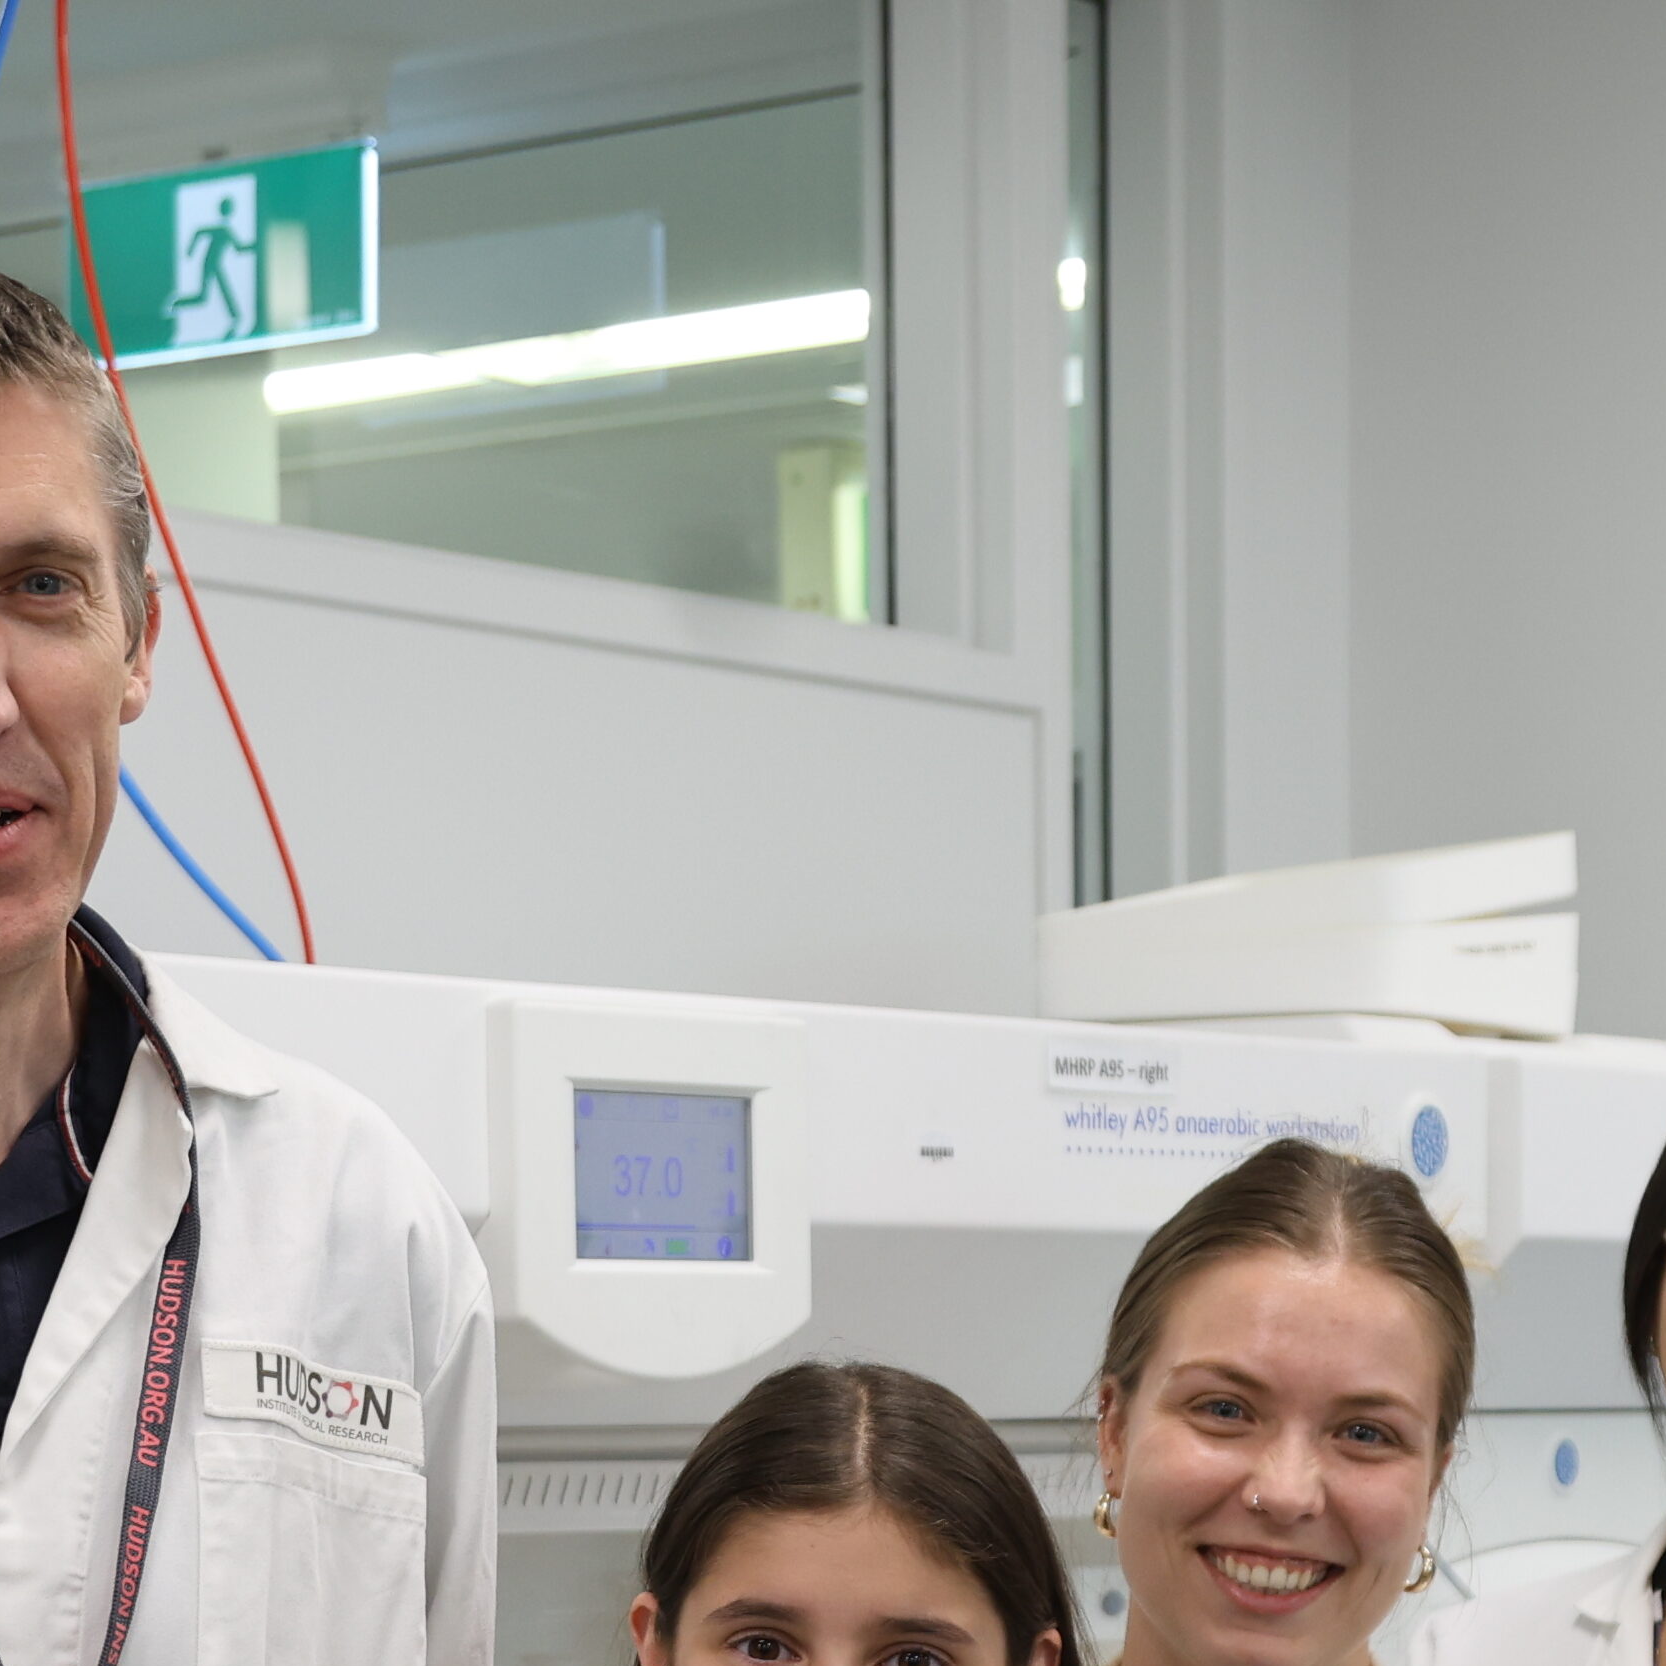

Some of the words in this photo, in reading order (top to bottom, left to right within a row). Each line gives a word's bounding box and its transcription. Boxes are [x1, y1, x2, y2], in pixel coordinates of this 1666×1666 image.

[1055, 1056, 1095, 1077] MHRP
[1099, 1060, 1125, 1078] A95
[1139, 1060, 1170, 1085] right
[1064, 1102, 1127, 1138] whitley
[1134, 1106, 1169, 1132] A95
[1176, 1108, 1260, 1136] anaerobic
[614, 1154, 683, 1198] 37.0
[135, 1259, 189, 1467] HUDSON.ORG.AU
[255, 1351, 393, 1430] HUDSON
[328, 1425, 388, 1445] RESEARCH
[118, 1505, 152, 1617] HUDSON
